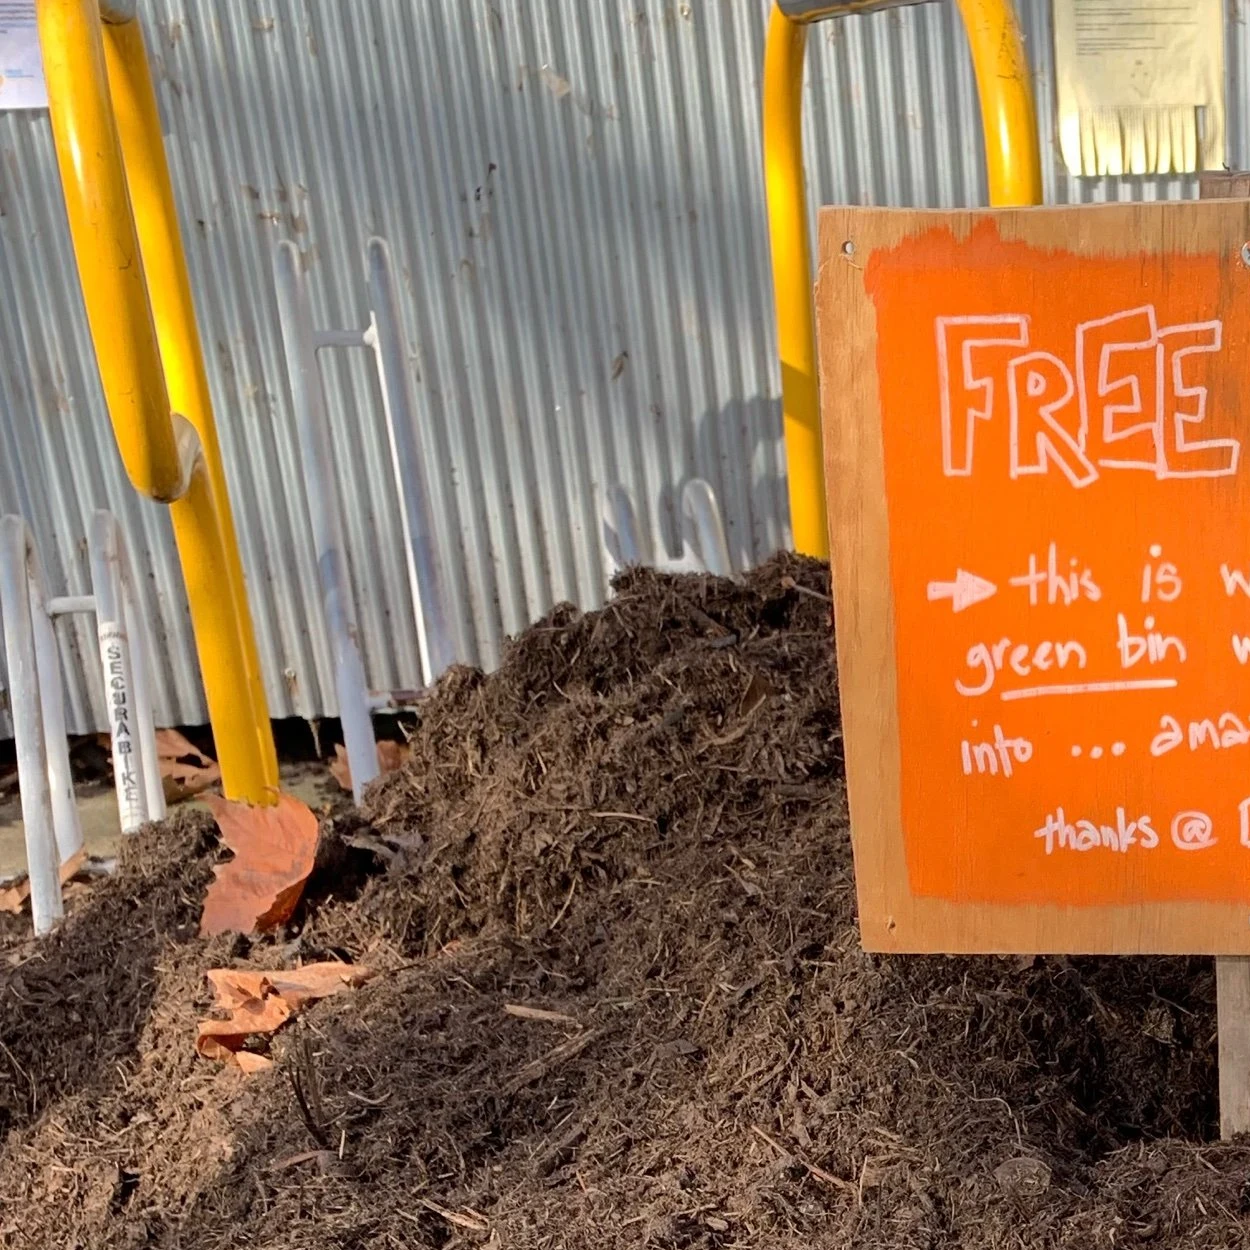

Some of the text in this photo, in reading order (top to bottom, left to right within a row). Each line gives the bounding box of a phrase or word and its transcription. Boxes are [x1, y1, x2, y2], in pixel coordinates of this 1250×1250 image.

[936, 304, 1241, 488] FREE
[1010, 544, 1103, 606] this
[1142, 544, 1183, 602] is
[956, 641, 1087, 696] green
[1117, 613, 1187, 669] bin
[107, 646, 137, 801] SECURABIKE
[961, 720, 1035, 777] into
[1034, 797, 1161, 854] thanks
[1170, 810, 1216, 850] @
